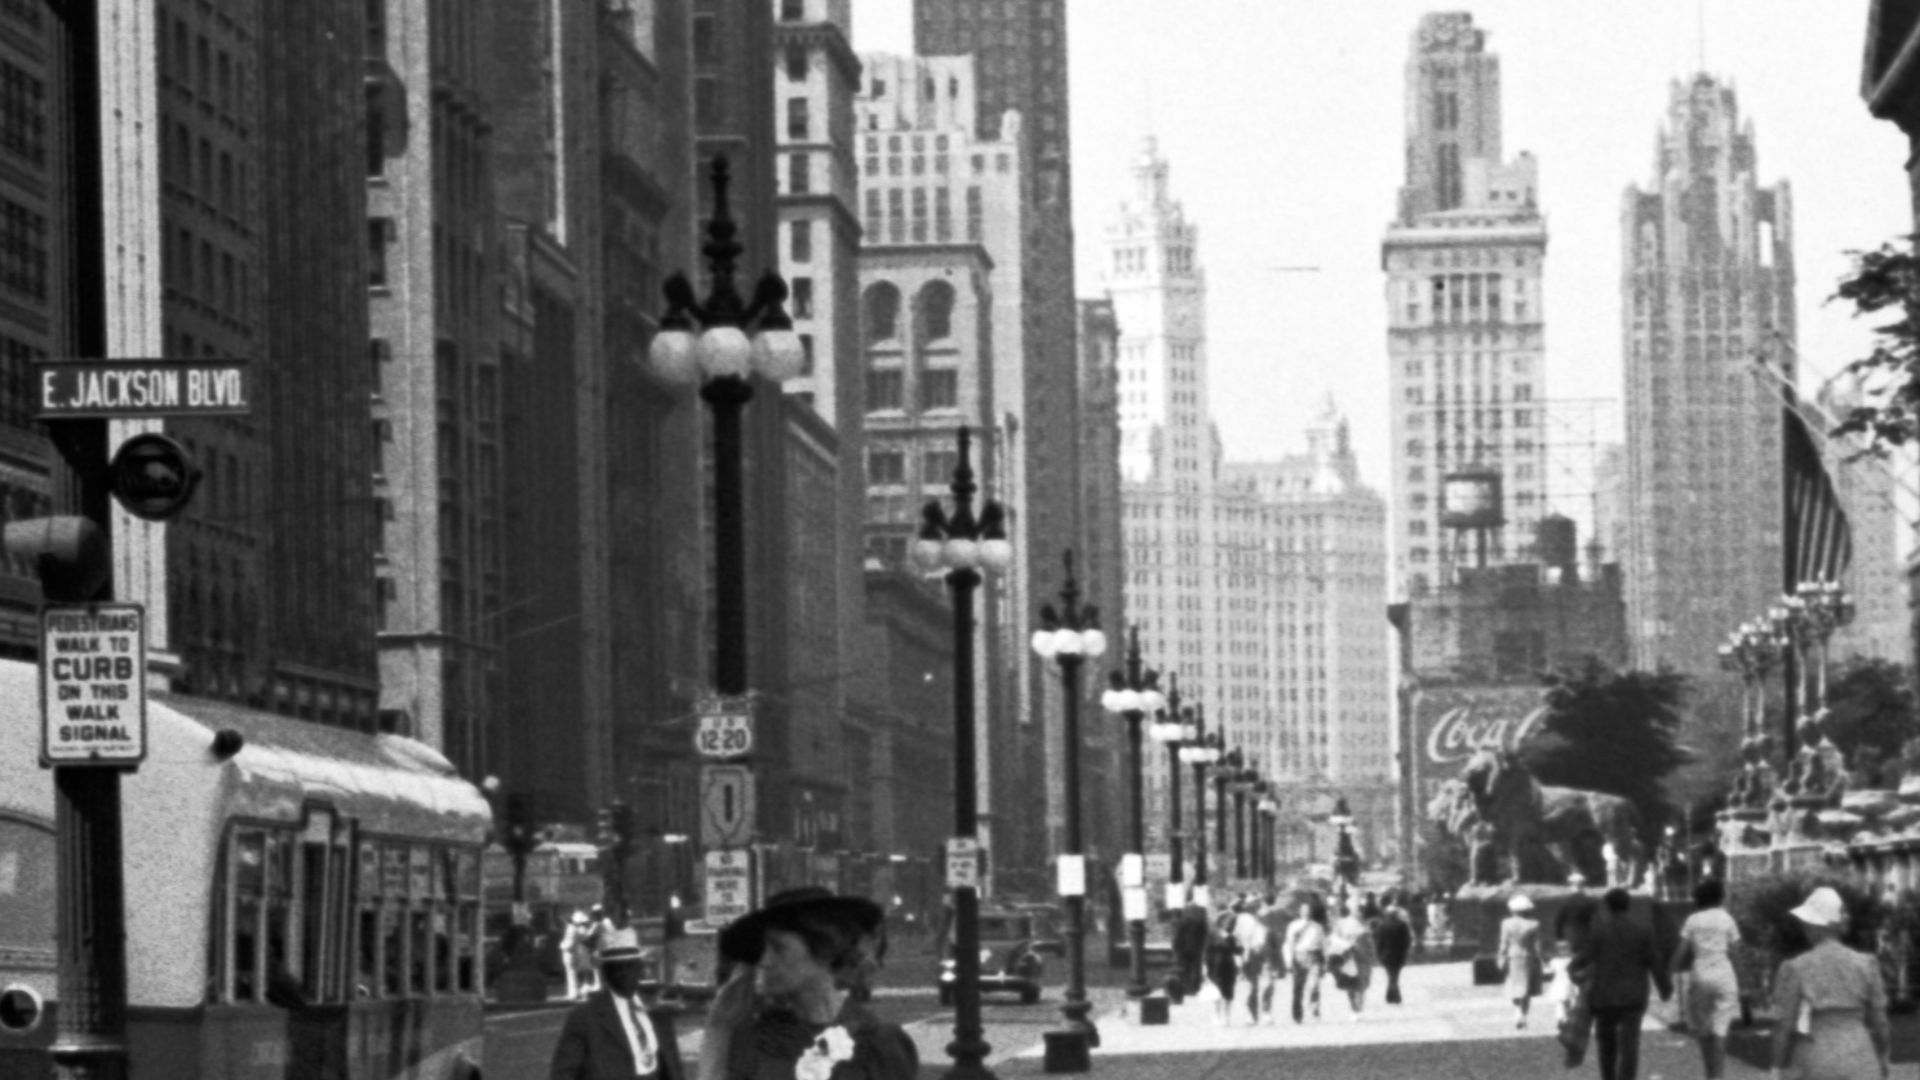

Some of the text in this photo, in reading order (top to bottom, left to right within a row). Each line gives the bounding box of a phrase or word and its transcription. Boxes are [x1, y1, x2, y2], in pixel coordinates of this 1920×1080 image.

[42, 369, 247, 408] E. JACKSON BLVD.
[55, 636, 130, 652] WALK TO
[52, 657, 133, 680] CURB
[58, 684, 129, 701] ON THIS
[66, 705, 120, 721] WALK
[59, 725, 132, 742] SIGNAL
